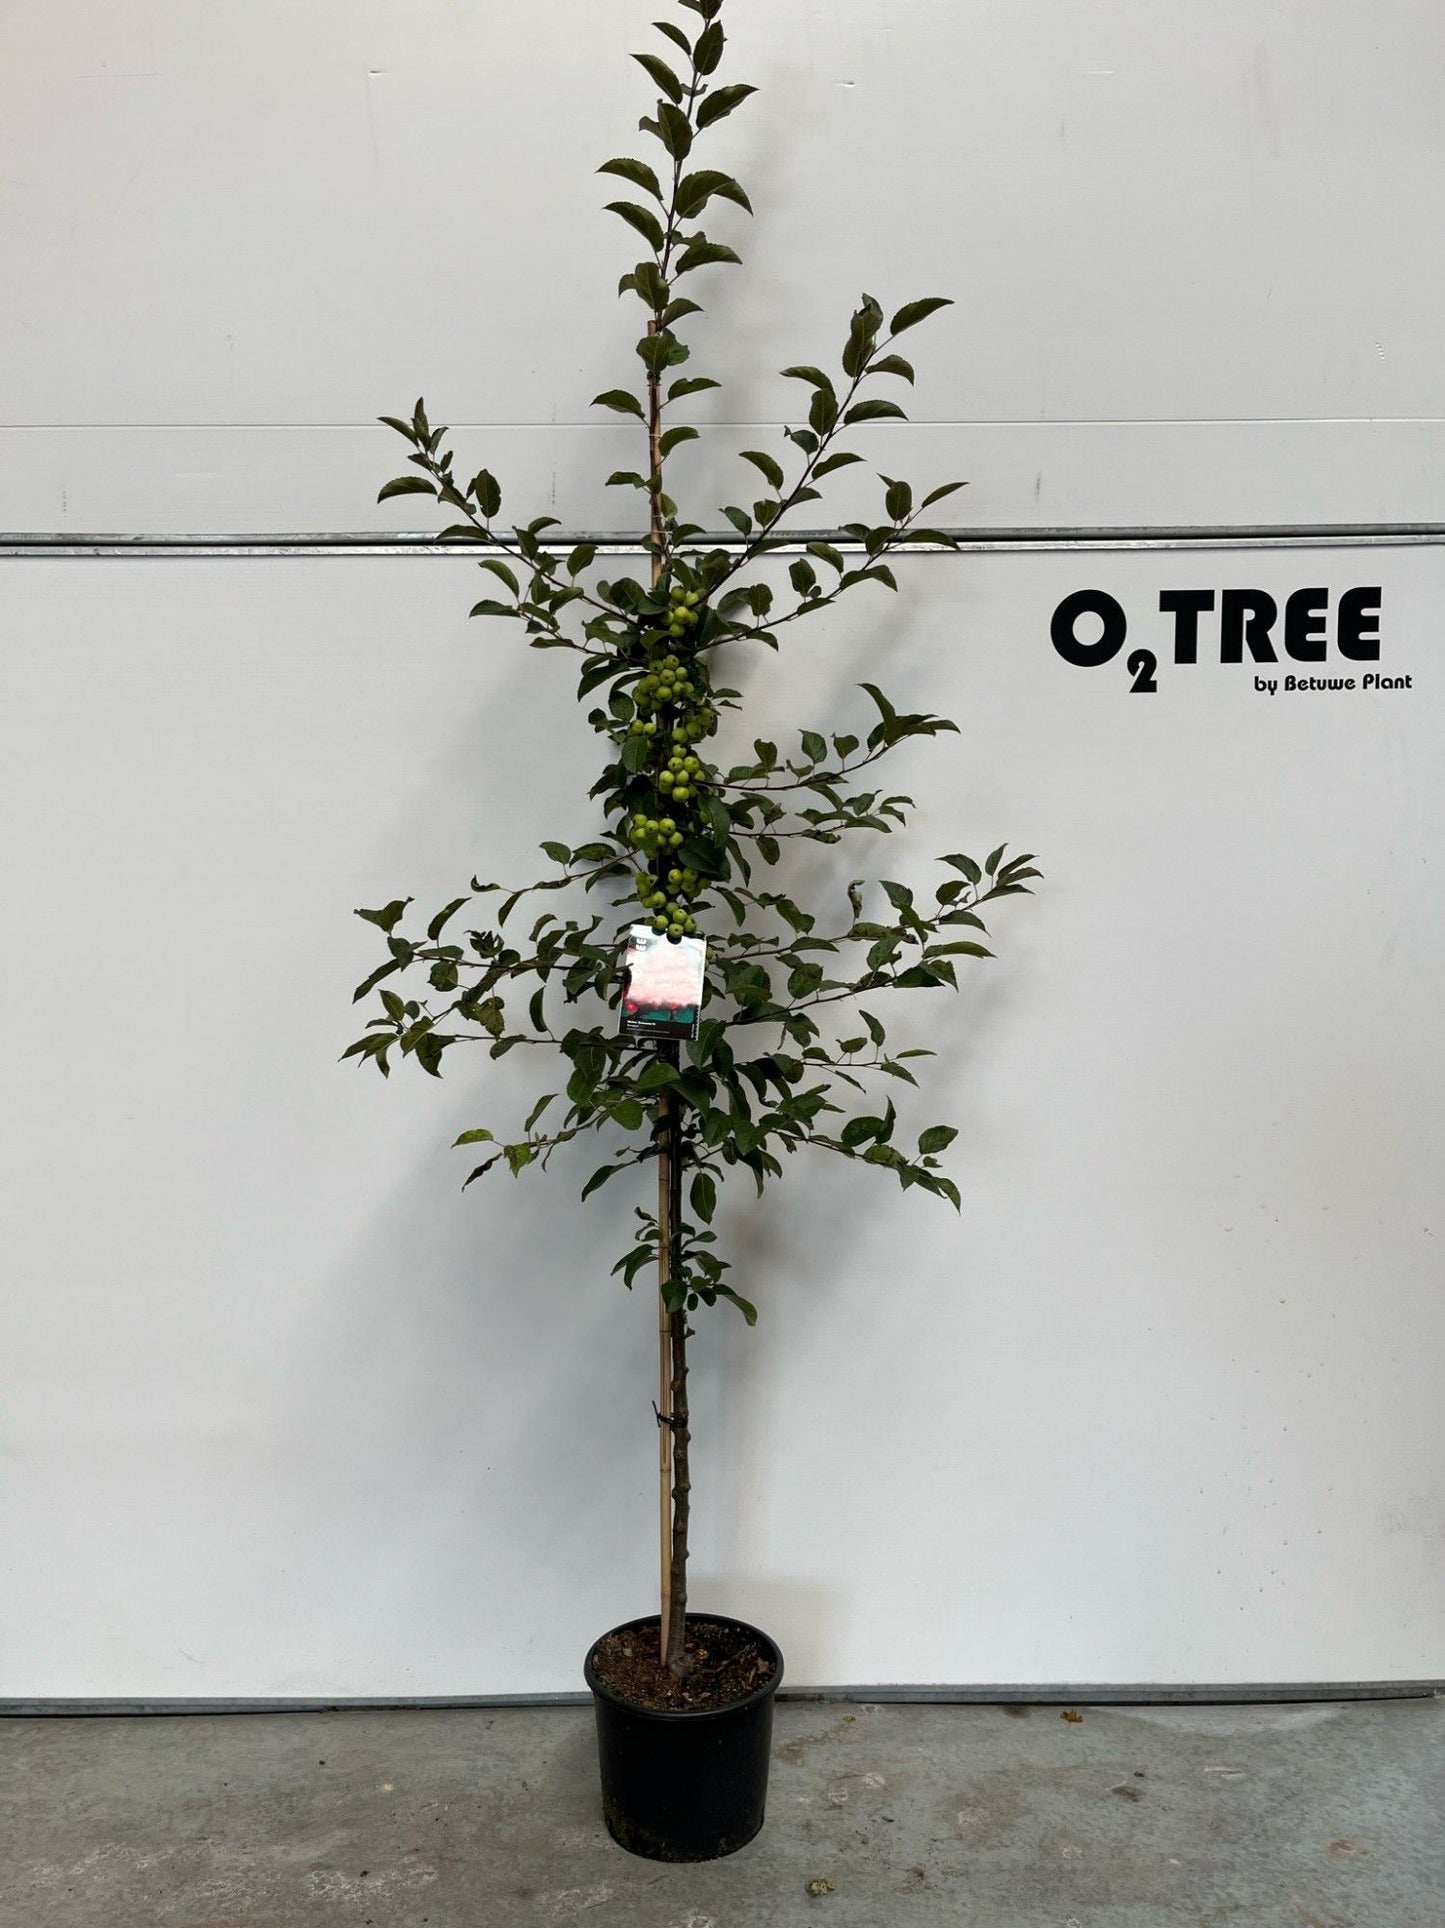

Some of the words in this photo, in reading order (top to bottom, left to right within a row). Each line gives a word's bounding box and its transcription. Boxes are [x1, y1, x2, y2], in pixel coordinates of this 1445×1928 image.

[1254, 675, 1279, 696] by
[1284, 674, 1357, 692] Betuwe
[1362, 673, 1413, 690] Plant
